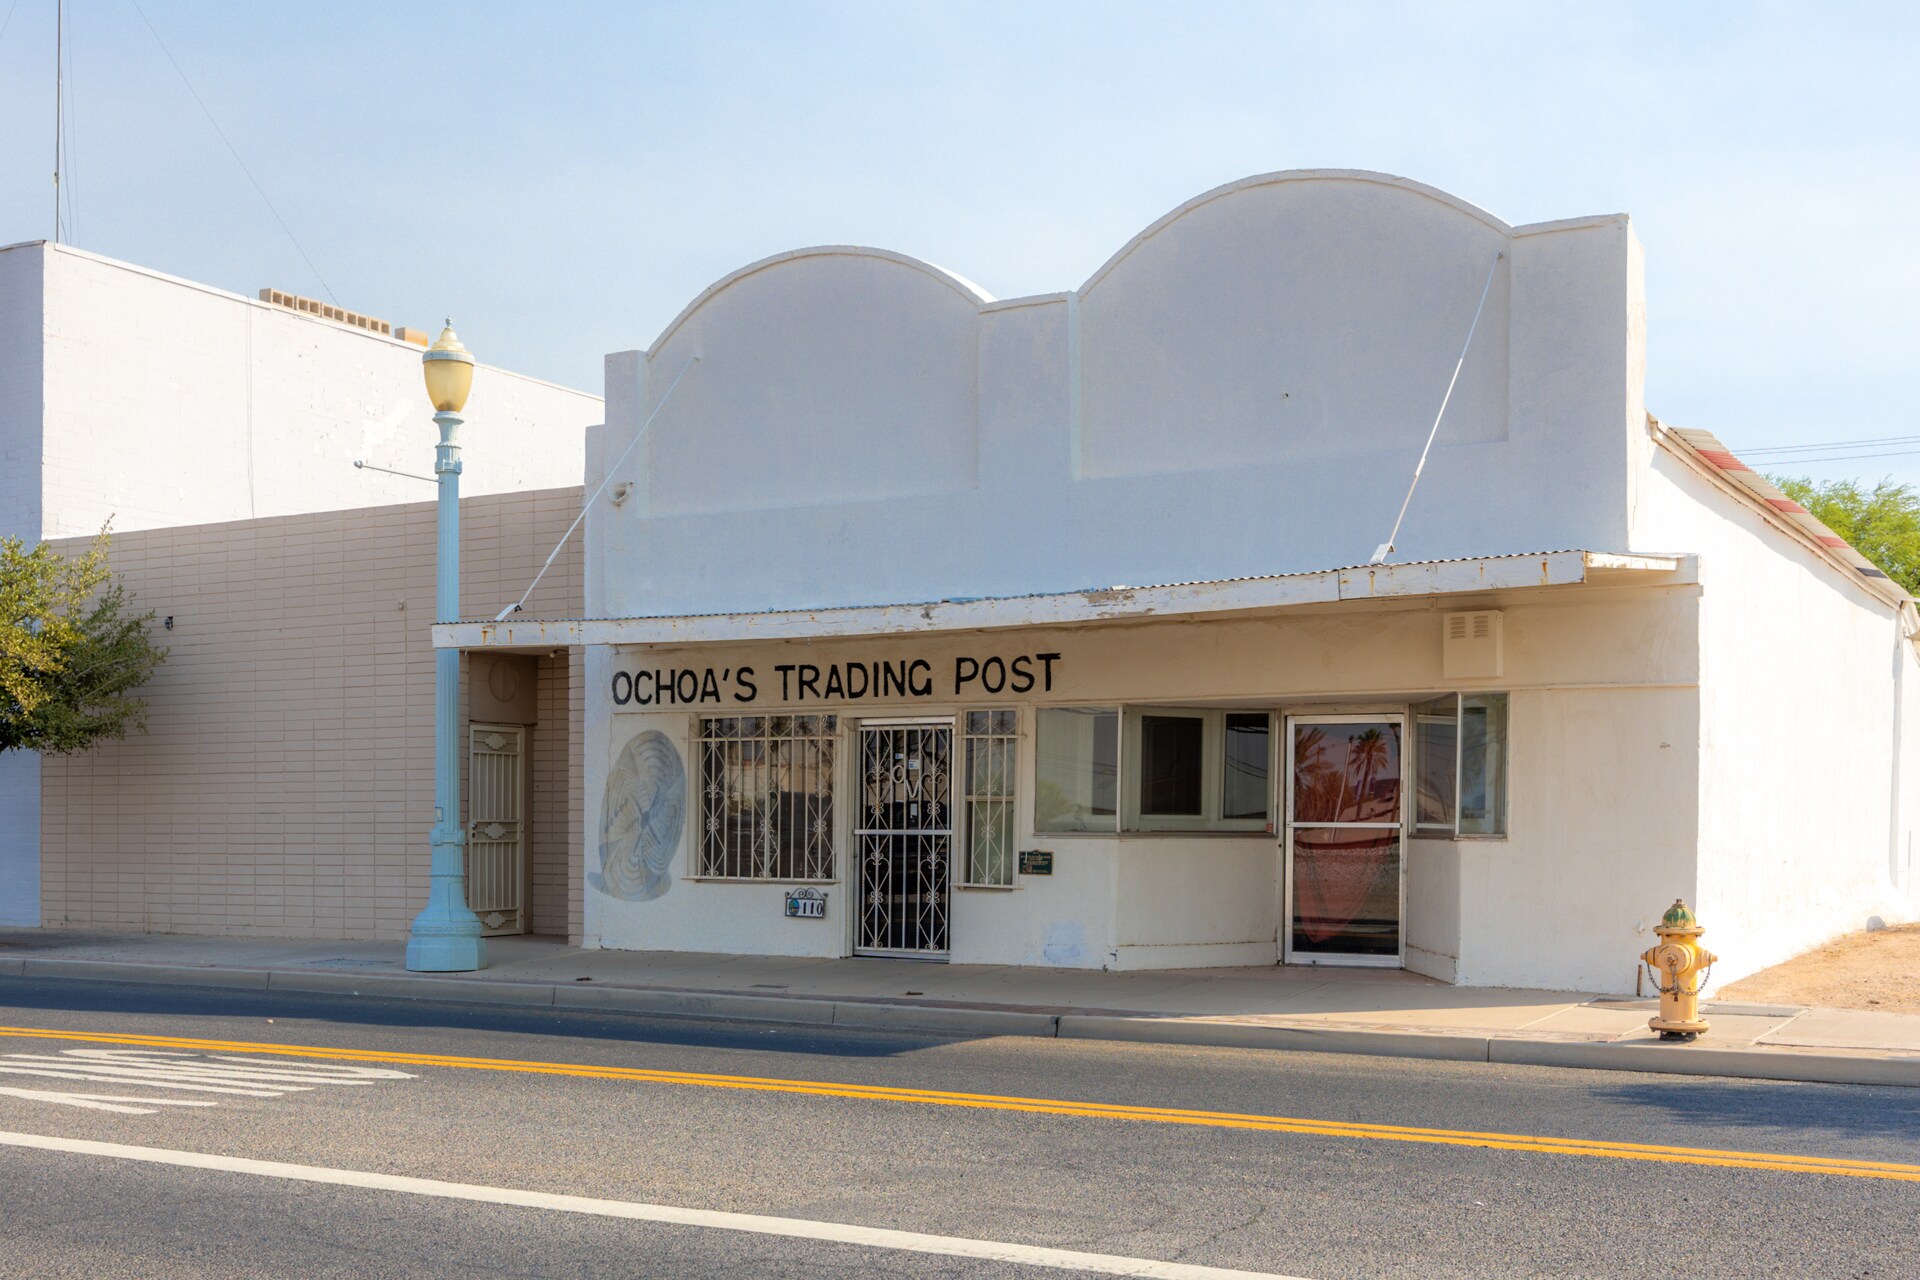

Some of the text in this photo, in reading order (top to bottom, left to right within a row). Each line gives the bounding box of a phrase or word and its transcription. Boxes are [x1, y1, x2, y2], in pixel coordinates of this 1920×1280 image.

[611, 652, 1062, 706] OCHOA'S TRADING POST
[802, 901, 823, 915] 110
